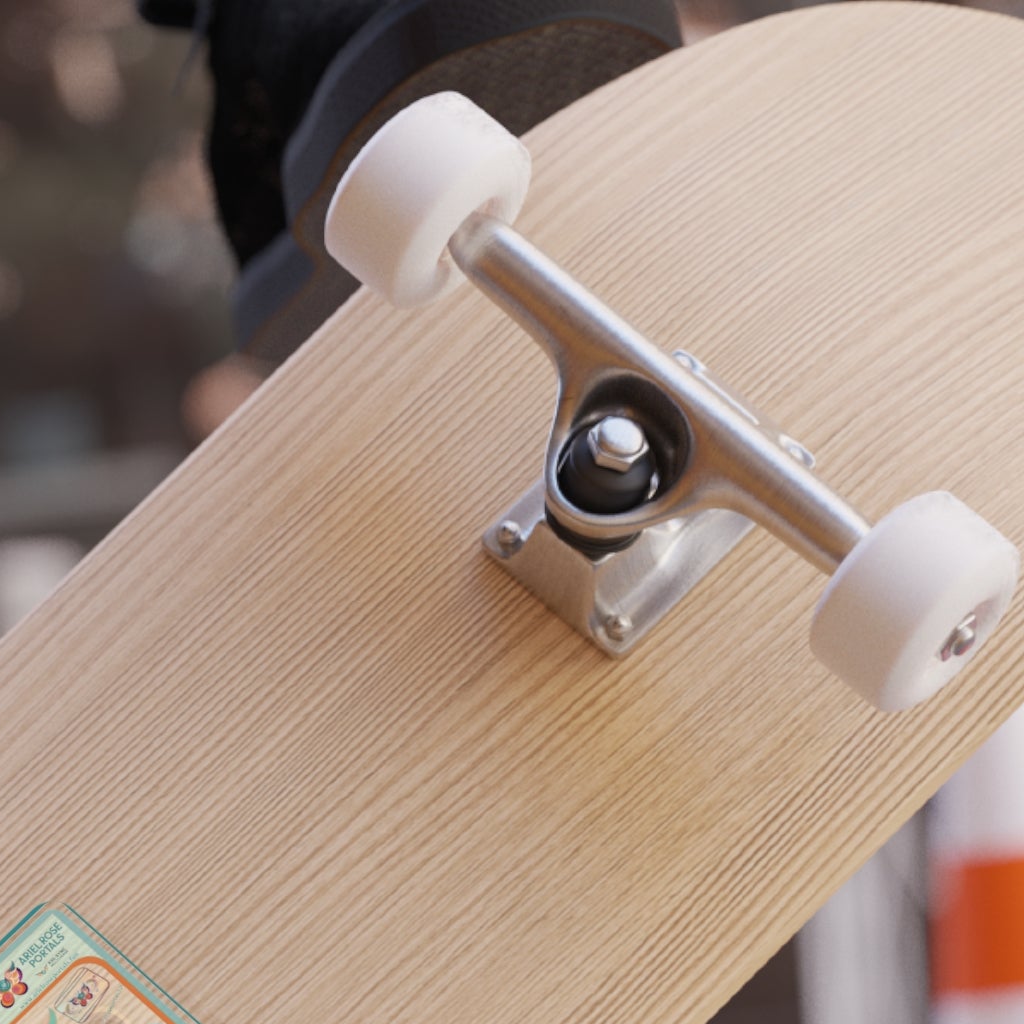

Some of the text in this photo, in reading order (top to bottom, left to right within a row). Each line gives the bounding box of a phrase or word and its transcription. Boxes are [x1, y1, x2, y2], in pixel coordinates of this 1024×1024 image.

[18, 943, 43, 966] ARIEL
[38, 922, 63, 945] ROSE
[29, 933, 65, 968] PORTALS
